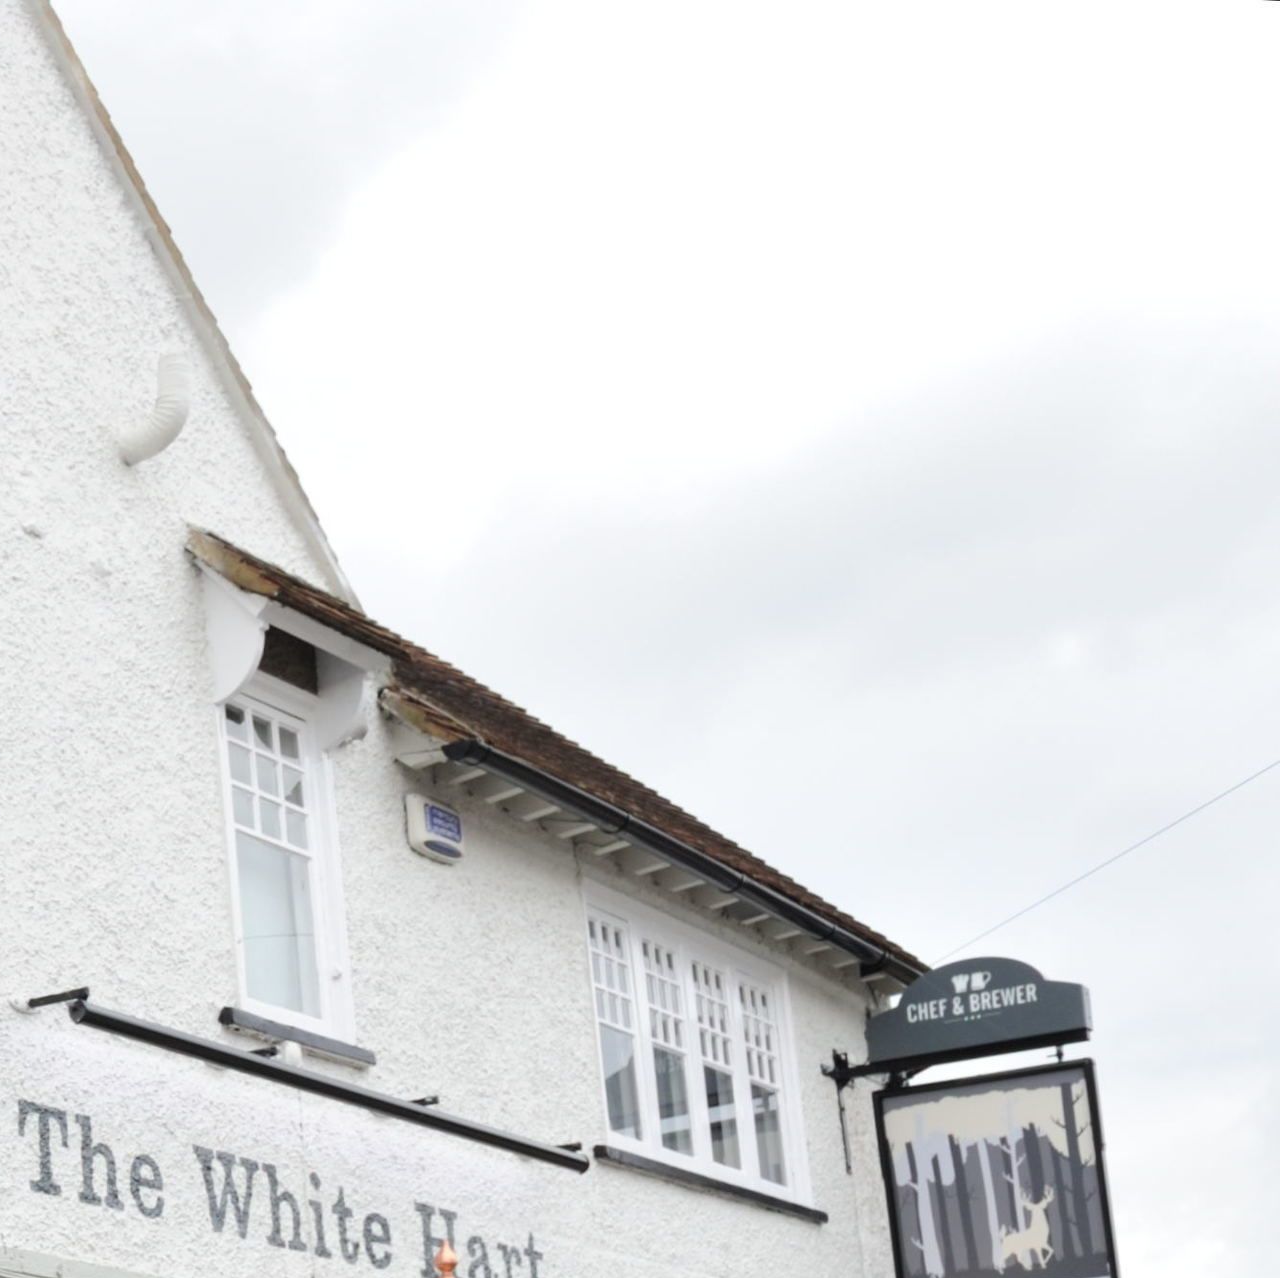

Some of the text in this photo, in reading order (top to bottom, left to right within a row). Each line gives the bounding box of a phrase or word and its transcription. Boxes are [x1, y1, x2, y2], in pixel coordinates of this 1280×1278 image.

[905, 983, 1038, 1024] CHEF & BREWER
[17, 1099, 164, 1220] The
[193, 1145, 393, 1270] White
